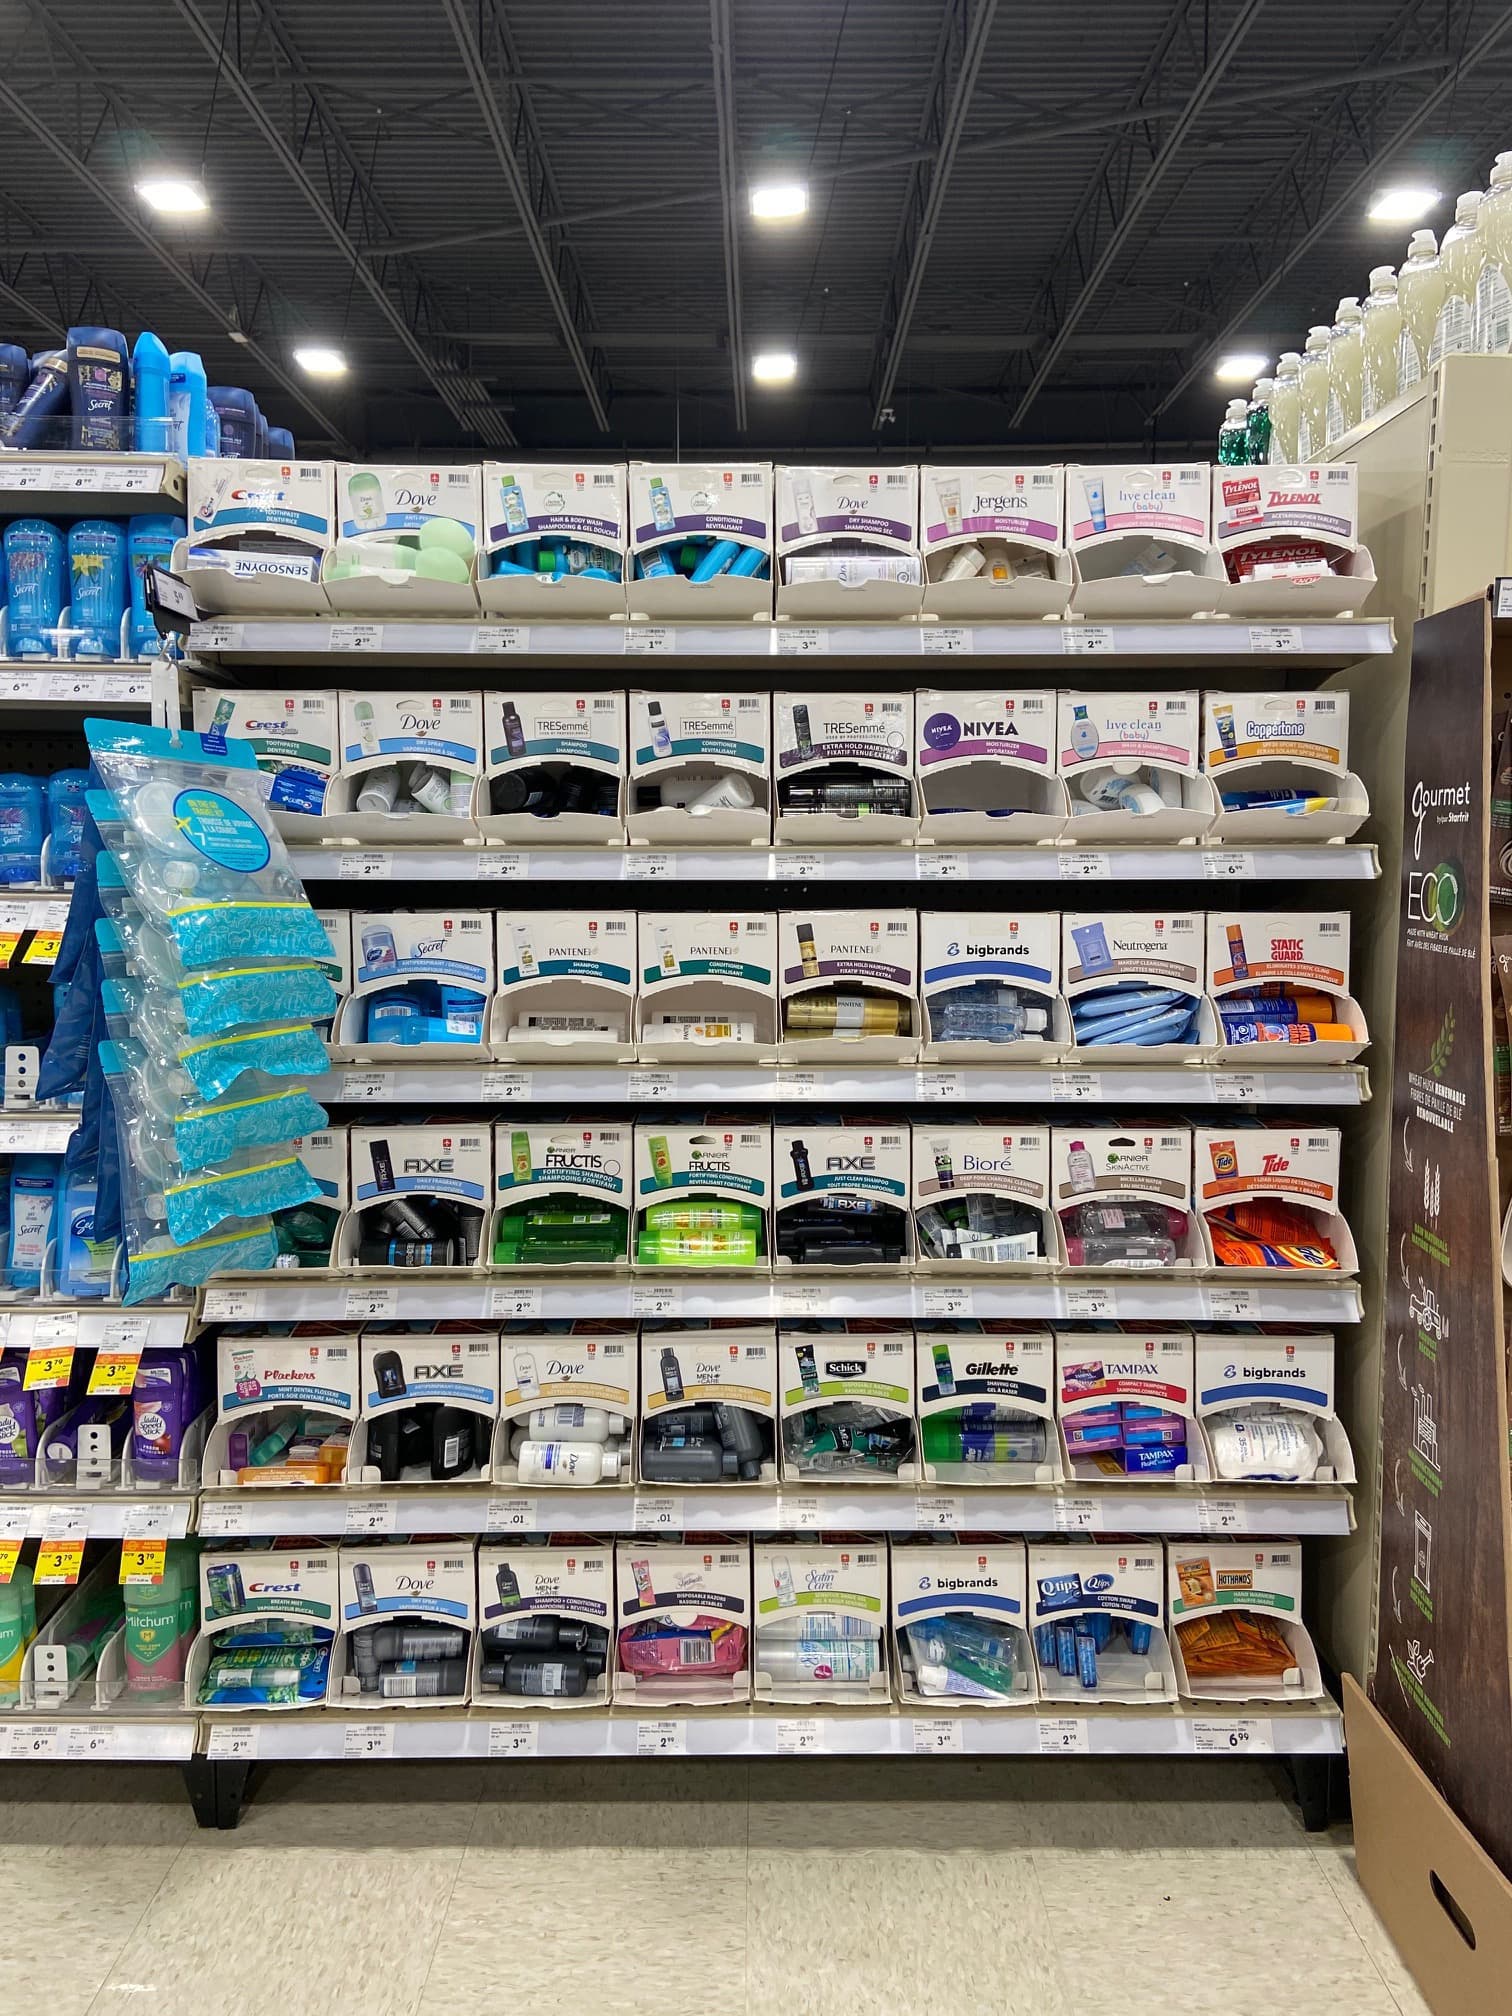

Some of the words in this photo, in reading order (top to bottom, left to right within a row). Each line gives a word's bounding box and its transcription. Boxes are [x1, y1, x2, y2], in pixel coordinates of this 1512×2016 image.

[88, 399, 114, 411] Secret
[1223, 481, 1260, 495] TYLENOL
[395, 489, 436, 506] Dove
[1119, 490, 1141, 501] live
[1143, 490, 1176, 500] clean
[1267, 491, 1322, 508] TYLENOL
[836, 496, 868, 509] Dove
[973, 494, 1027, 513] Jergens
[1132, 501, 1163, 512] (baby)
[706, 516, 743, 525] CONDITIONER
[861, 518, 889, 527] SHAMPOO
[705, 523, 743, 531] REVITALISANT
[844, 525, 876, 533] SHAMPOOING
[1239, 546, 1319, 562] TYLENOL
[235, 561, 308, 575] SENSODYNE
[245, 720, 289, 730] Crest
[401, 713, 441, 731] Dove
[537, 721, 590, 731] TRESemmé
[682, 721, 734, 731] TRESemmé
[1106, 719, 1127, 729] live
[1131, 720, 1161, 730] clean
[823, 722, 885, 734] TRESemmé
[963, 721, 1019, 736] NIVEA
[1247, 721, 1304, 738] Coppertone
[1119, 731, 1149, 740] (baby)
[561, 741, 587, 749] SHAMPOO
[702, 740, 737, 749] CONDITIONER
[986, 741, 1020, 749] MOISTURIZER
[556, 747, 591, 756] SHAMPOOING
[701, 747, 736, 755] REVITALISANT
[1412, 780, 1471, 861] gourmet
[1449, 812, 1469, 823] Starfrit
[1407, 872, 1458, 925] ECO
[414, 939, 447, 958] Secret
[831, 945, 870, 954] PANTENE
[966, 944, 1030, 956] bigbrands
[1113, 940, 1168, 952] Neutrogena
[1271, 939, 1303, 950] STATIC
[549, 948, 588, 956] PANTENE
[690, 946, 729, 955] PANTENE
[1271, 951, 1304, 960] GUARD
[573, 961, 600, 969] SHAMPOO
[709, 961, 744, 969] CONDITIONER
[568, 967, 603, 976] SHAMPOOING
[708, 968, 743, 976] REVITALISANT
[876, 971, 892, 979] EXTRA
[545, 1155, 602, 1168] FRUCTIS
[826, 1156, 875, 1171] AXE
[963, 1155, 1012, 1171] Bioré
[1107, 1153, 1148, 1163] GARNIER
[1215, 1156, 1234, 1168] Tide
[403, 1159, 455, 1173] AXE
[689, 1161, 730, 1171] FRUCTIS
[1262, 1154, 1290, 1175] Tide
[543, 1169, 580, 1177] FORTIFYING
[580, 1171, 613, 1182] SHAMPOO
[848, 1175, 865, 1183] CLEAN
[866, 1177, 889, 1186] SHAMPOO
[838, 1200, 866, 1210] AXE
[18, 1224, 45, 1237] Secret
[414, 1364, 464, 1379] AXE
[546, 1360, 585, 1375] Dove
[696, 1362, 721, 1373] Dove
[829, 1363, 863, 1373] Schick
[965, 1362, 1018, 1376] Gillette
[1105, 1364, 1159, 1375] TAMPAX
[1243, 1367, 1306, 1379] bigbrands
[264, 1370, 316, 1381] Plackers
[1118, 1380, 1141, 1388] COMPACT
[314, 1389, 339, 1398] FLOSSERS
[1138, 1450, 1174, 1461] TAMPAX
[569, 1453, 578, 1476] Dove
[395, 1575, 434, 1591] Dove
[535, 1575, 560, 1585] Dove
[805, 1569, 834, 1586] Satin
[1218, 1573, 1251, 1586] HOTHANDS
[249, 1583, 301, 1593] Crest
[807, 1581, 833, 1591] Care
[937, 1578, 998, 1590] bigbrands
[567, 1600, 601, 1609] CONDITIONER
[1101, 1602, 1133, 1610] COTON-TIGE
[1118, 1597, 1137, 1605] SWABS
[530, 1604, 565, 1612] SHAMPOOING
[570, 1606, 605, 1616] REVITALISANT
[126, 1615, 175, 1628] Mitchum
